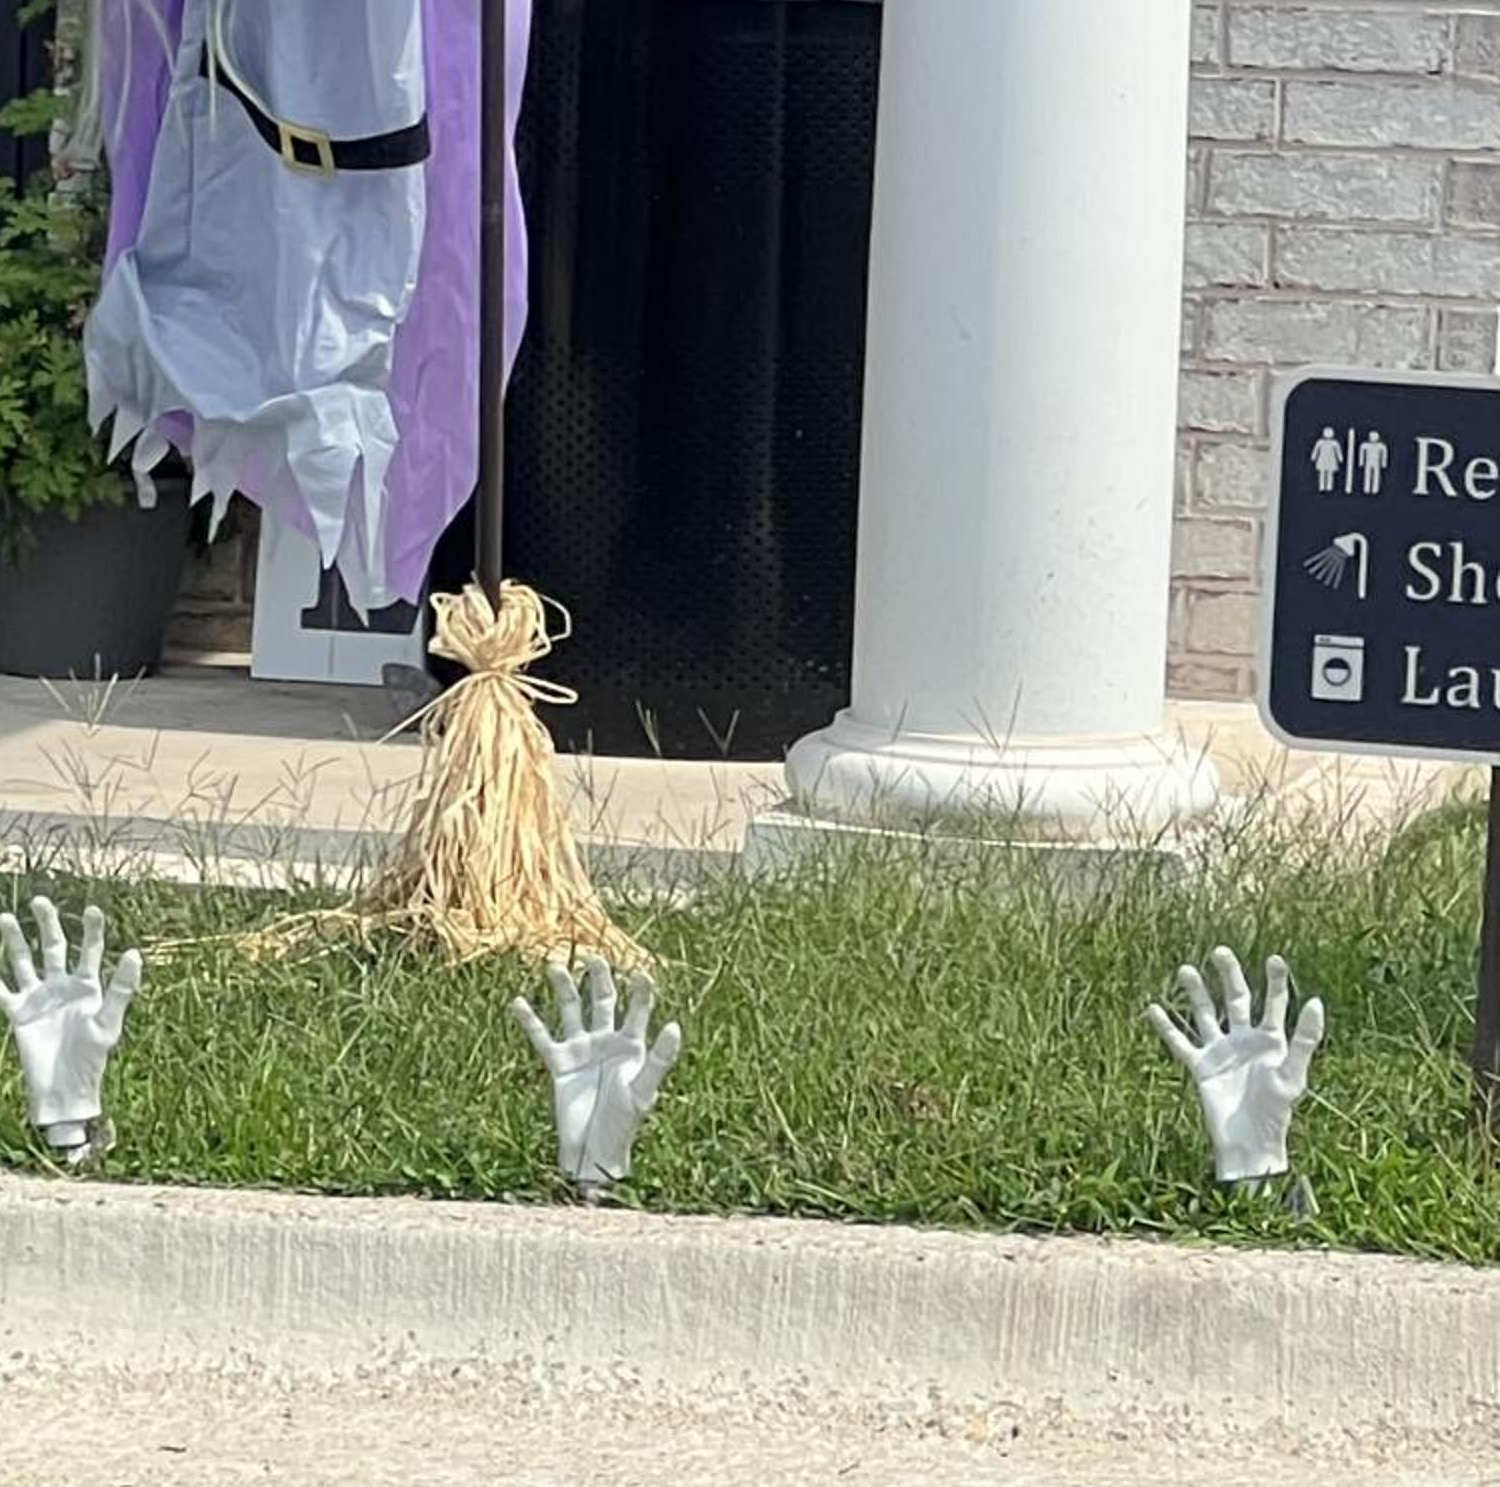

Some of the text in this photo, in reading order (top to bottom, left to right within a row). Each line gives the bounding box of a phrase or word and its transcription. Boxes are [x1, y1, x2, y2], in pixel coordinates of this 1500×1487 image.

[1412, 436, 1500, 500] Re
[1405, 541, 1500, 604] Sh
[1401, 645, 1500, 709] La
